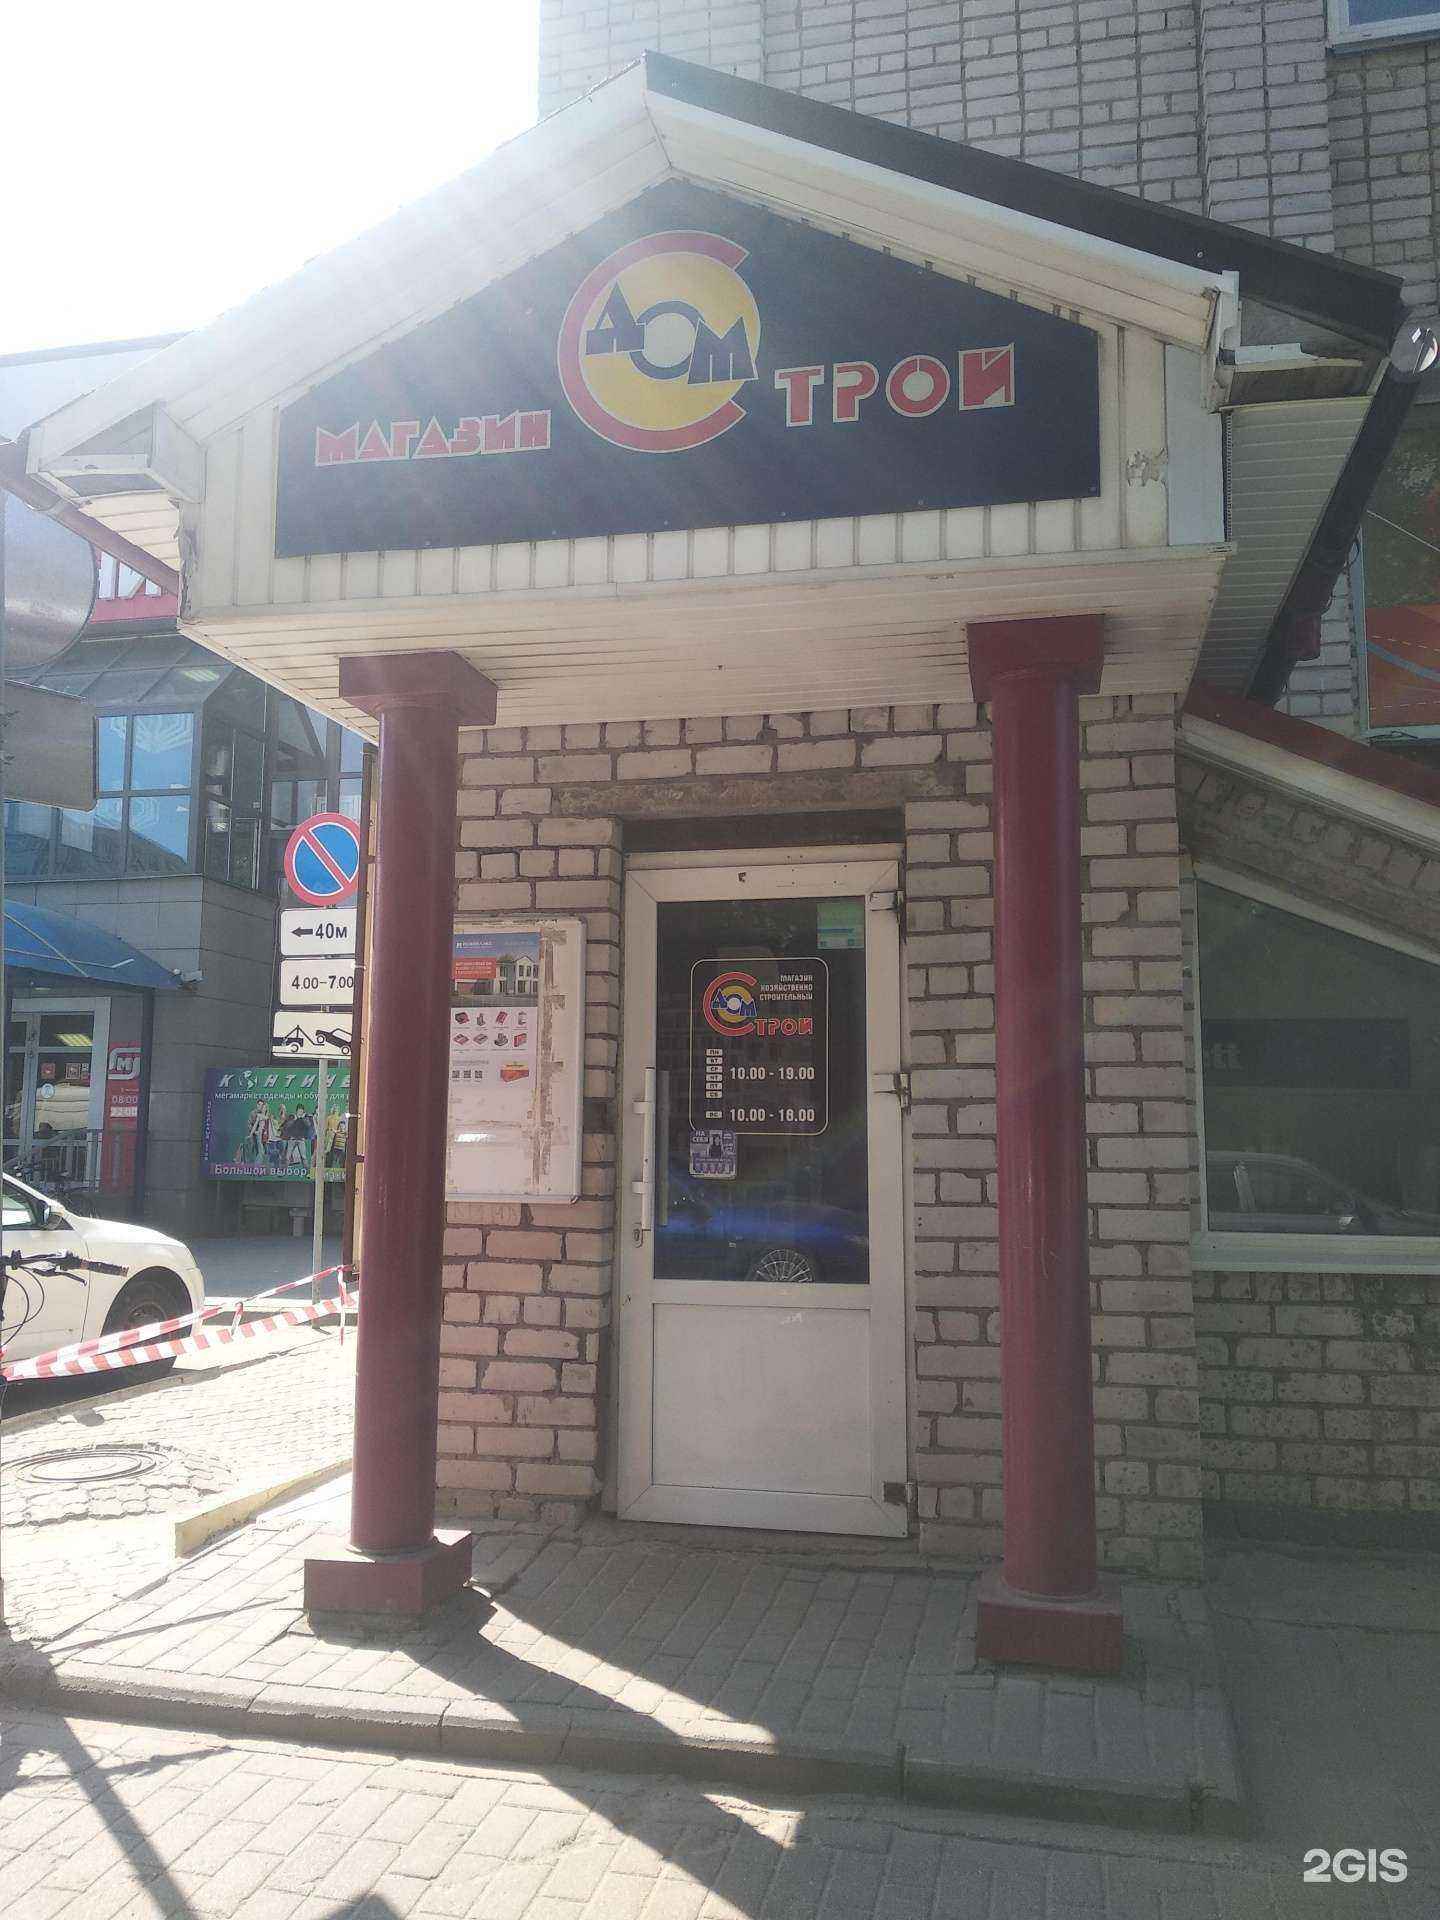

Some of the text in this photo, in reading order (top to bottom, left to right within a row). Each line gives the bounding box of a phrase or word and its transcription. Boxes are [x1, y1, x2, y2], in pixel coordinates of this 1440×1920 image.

[315, 409, 551, 466] МАГАЗИН
[780, 974, 813, 982] МАГАЗИН
[730, 1067, 766, 1080] 10.00
[779, 1067, 815, 1080] 19.00
[730, 1109, 766, 1122] 10.00
